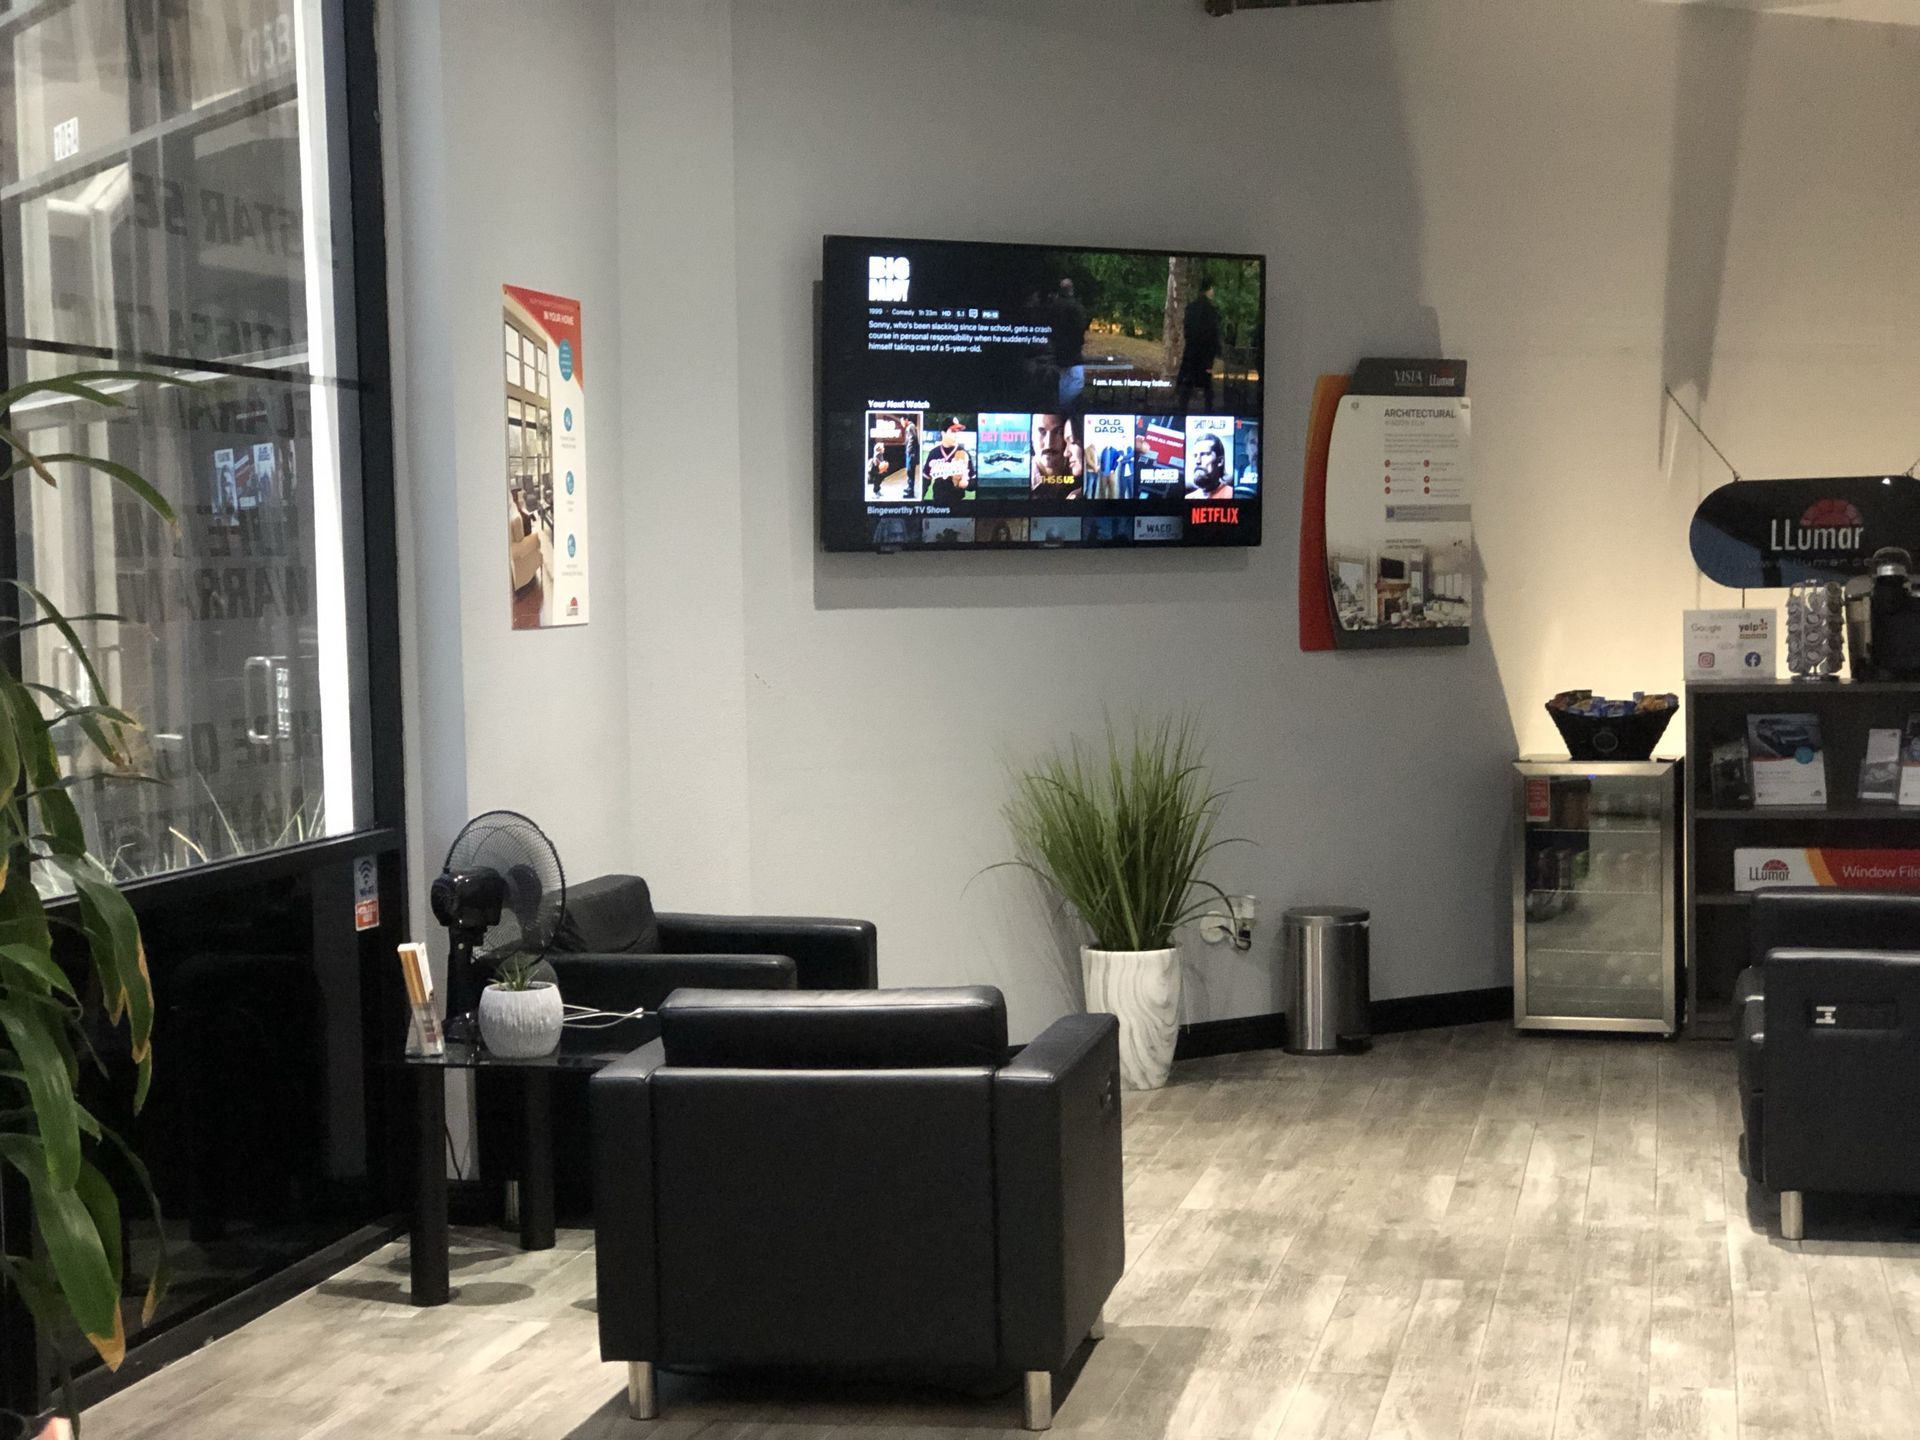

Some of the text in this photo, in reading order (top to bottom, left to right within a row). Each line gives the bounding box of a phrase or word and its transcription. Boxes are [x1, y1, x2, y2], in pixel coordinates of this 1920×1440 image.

[868, 256, 910, 279] BIG
[892, 308, 914, 316] Comedy
[869, 320, 892, 330] Sonny,
[932, 322, 958, 332] slacking
[990, 324, 1013, 333] school,
[1014, 326, 1028, 334] gets
[900, 333, 929, 341] personal
[930, 333, 973, 343] responsibility
[1002, 335, 1031, 344] suddenly
[868, 342, 893, 350] himself
[894, 343, 915, 352] taking
[931, 343, 938, 351] of
[945, 344, 982, 353] 5-year-old.
[1394, 370, 1423, 382] VISTA
[1384, 409, 1456, 418] ARCHITECTURAL
[1099, 418, 1121, 426] OLD
[1094, 426, 1125, 434] DADS
[1063, 475, 1075, 484] US
[867, 506, 950, 516] Bingeworthy TV Shows
[1192, 507, 1239, 524] NETFLIX
[1770, 519, 1864, 551] LLumar
[1691, 621, 1759, 633] Google yelp
[1749, 866, 1790, 881] LLumar
[1842, 864, 1897, 878] Window
